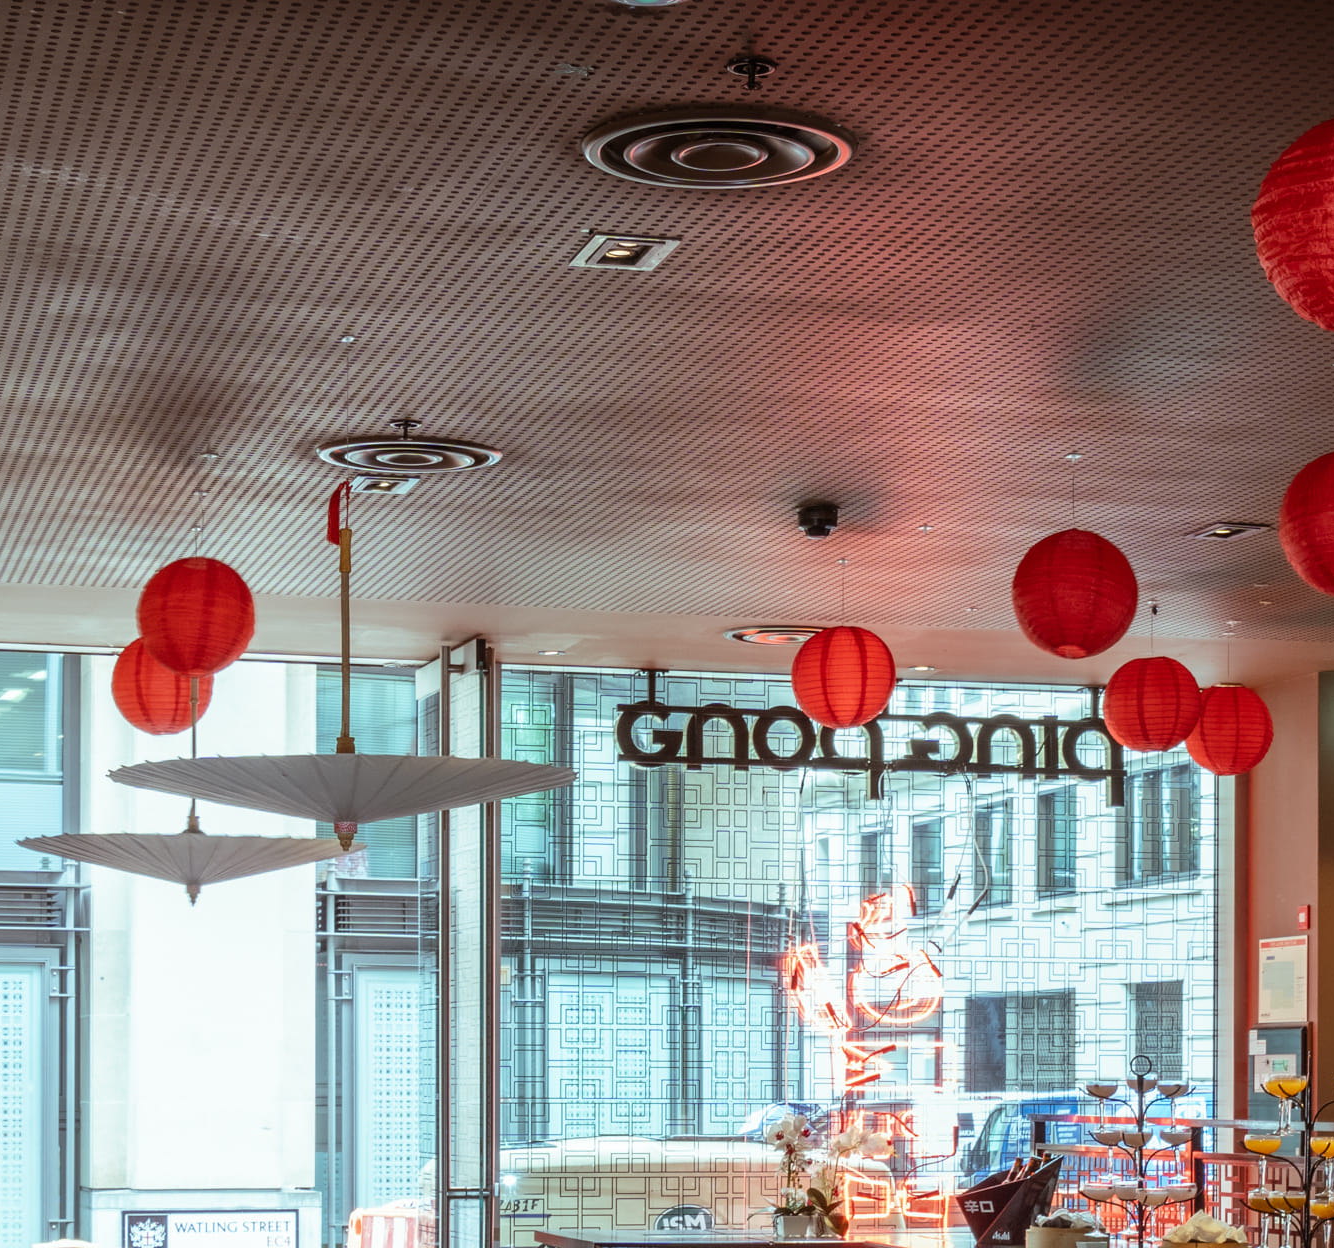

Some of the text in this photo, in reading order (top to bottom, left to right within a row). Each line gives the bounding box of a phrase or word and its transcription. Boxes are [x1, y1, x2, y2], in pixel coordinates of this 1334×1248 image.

[964, 1200, 995, 1214] 辛口
[174, 1220, 292, 1233] WATLING STREET
[267, 1235, 291, 1247] EC4
